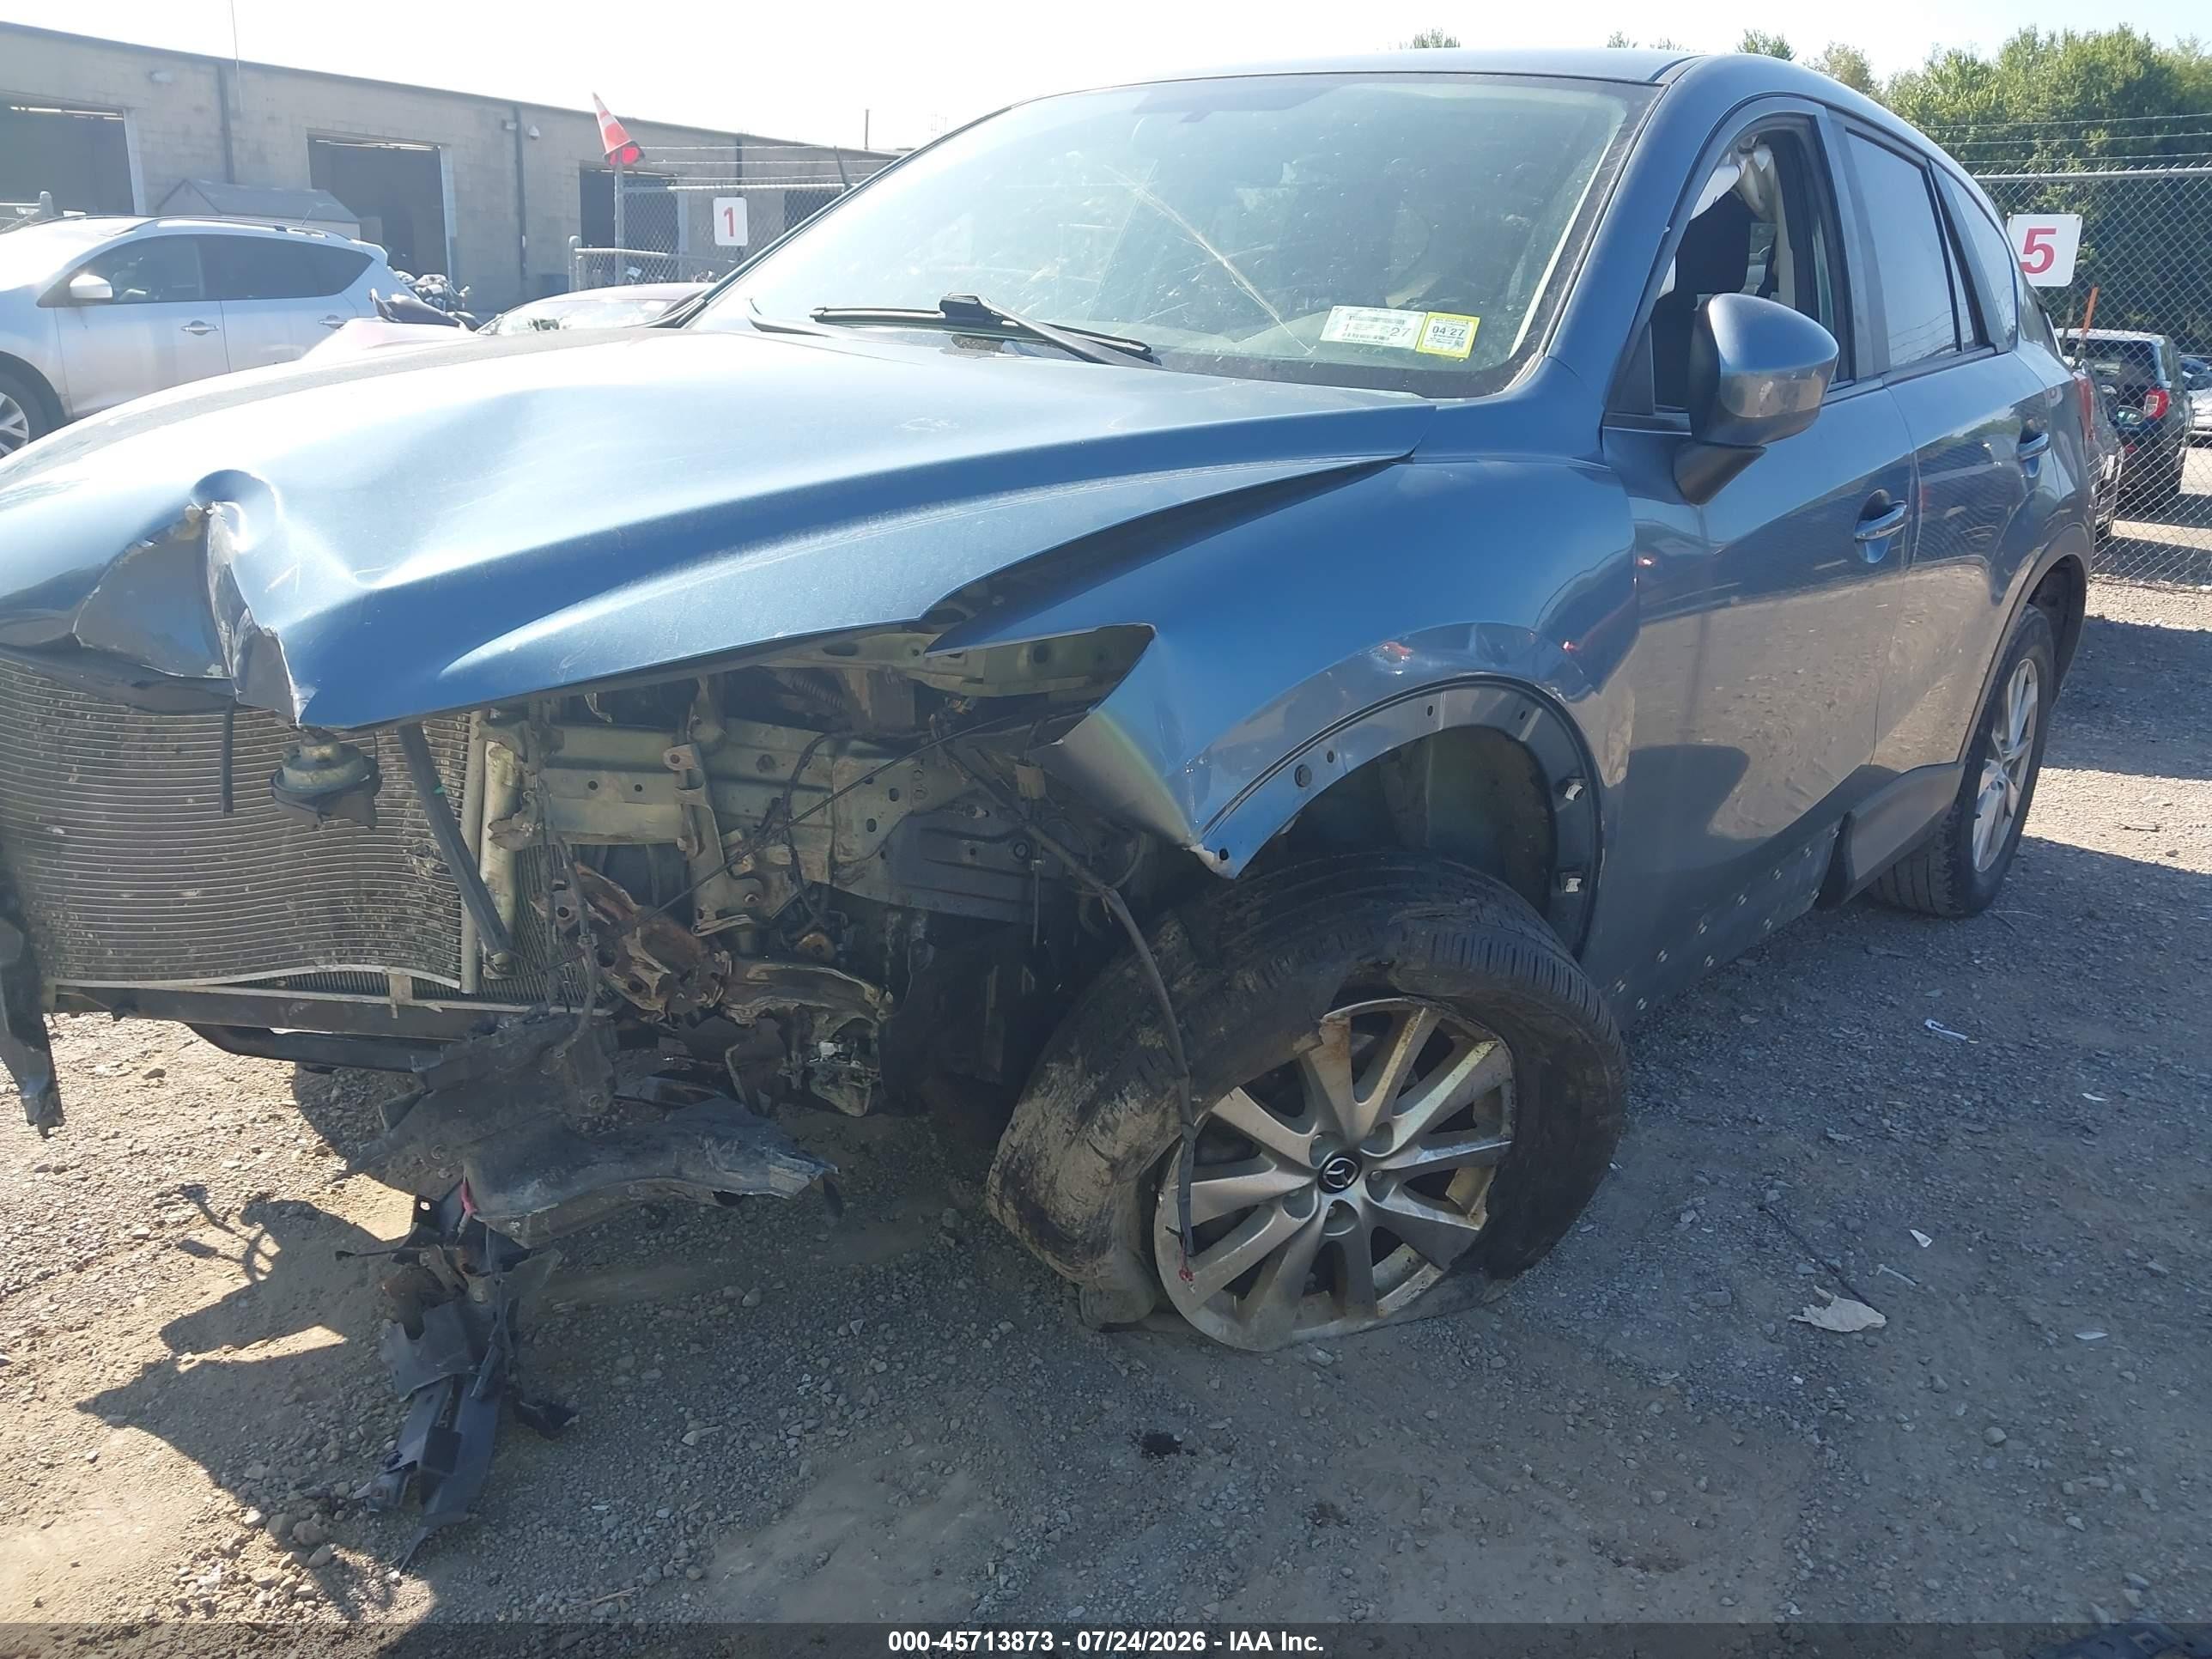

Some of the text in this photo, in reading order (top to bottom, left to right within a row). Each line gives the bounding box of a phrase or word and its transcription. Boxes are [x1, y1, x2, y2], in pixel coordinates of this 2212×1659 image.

[723, 206, 734, 237] 1
[2019, 228, 2057, 274] 5
[1389, 326, 1413, 337] 27
[1432, 325, 1465, 337] 04 27
